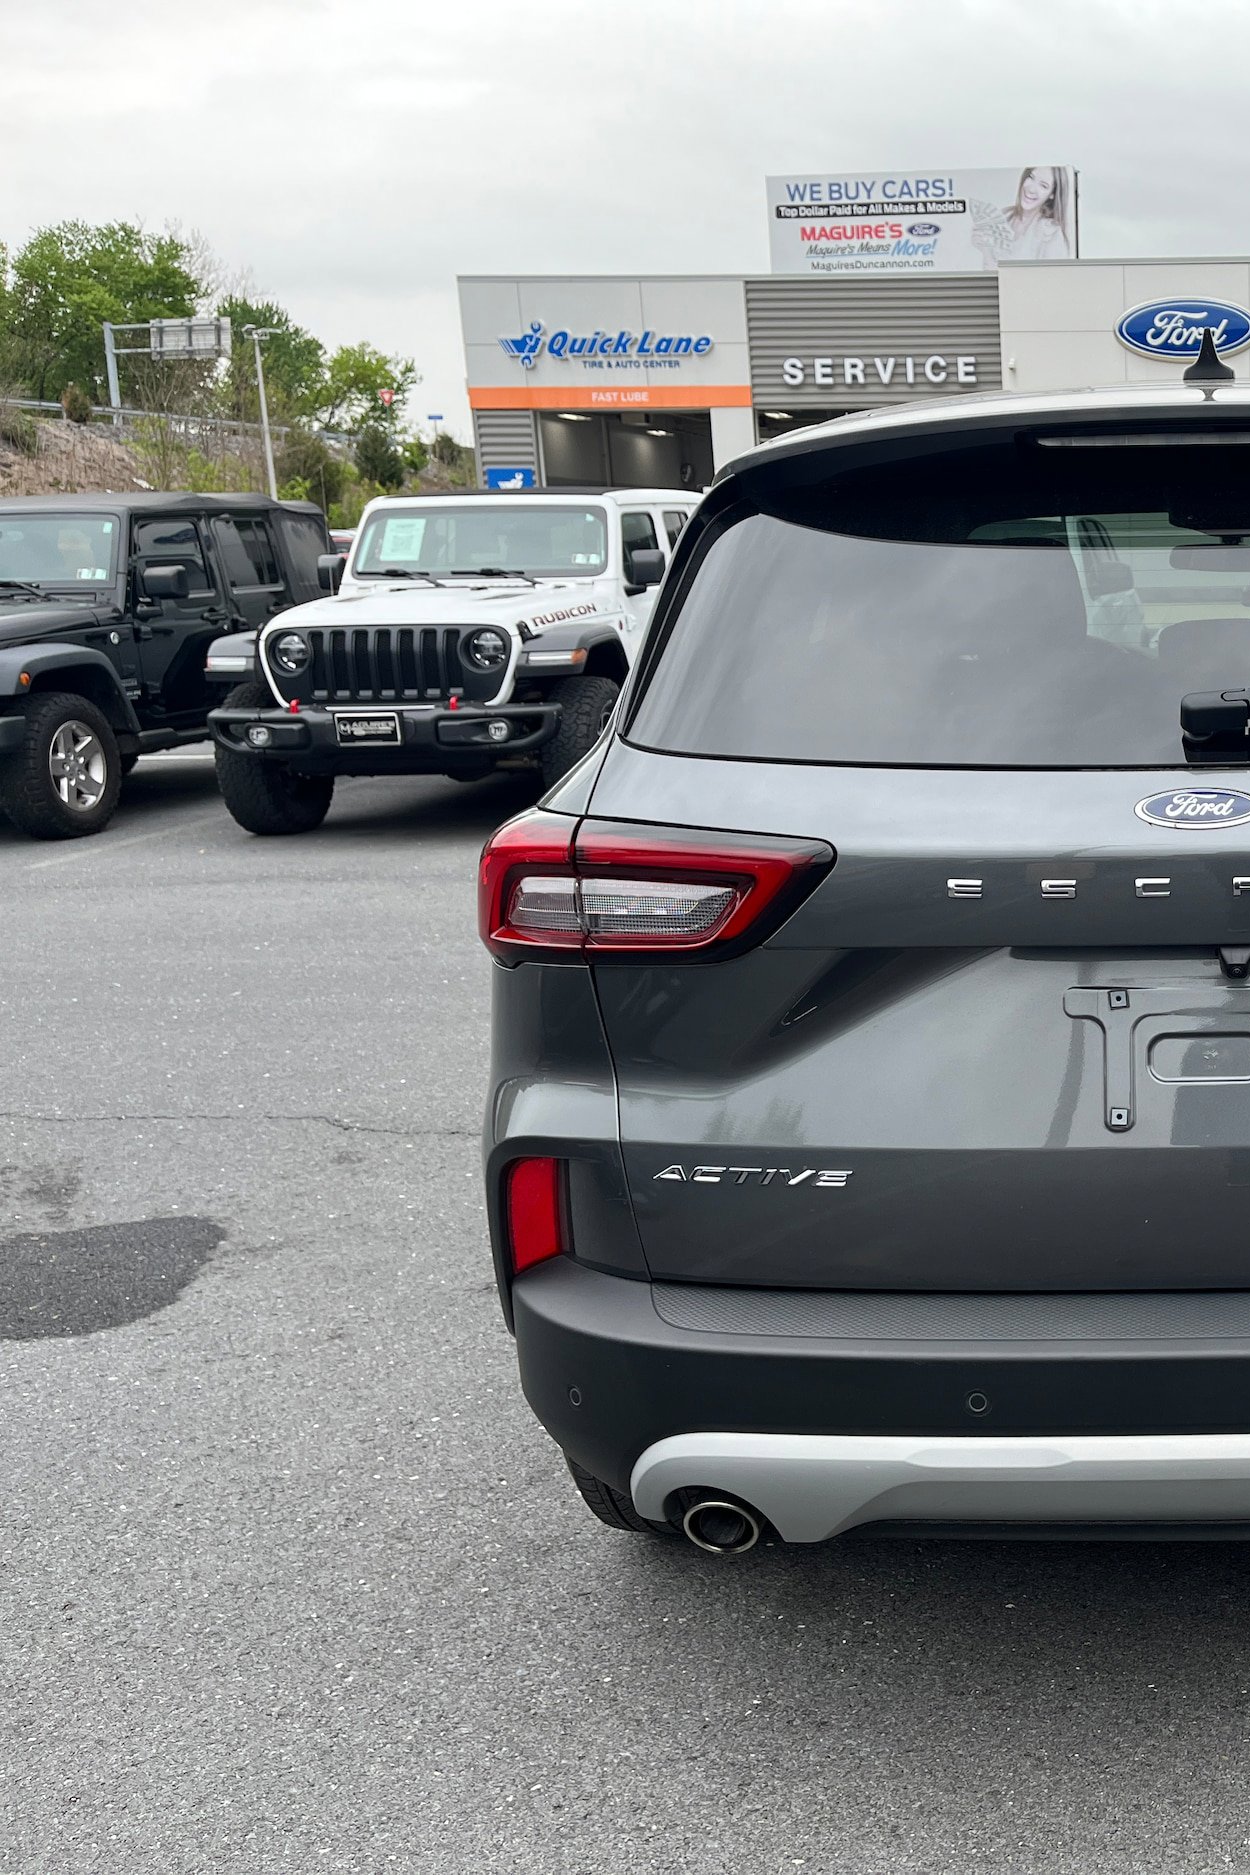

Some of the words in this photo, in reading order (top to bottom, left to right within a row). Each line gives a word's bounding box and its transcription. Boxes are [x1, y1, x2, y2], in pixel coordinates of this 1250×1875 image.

[786, 183, 822, 202] WE
[828, 180, 876, 201] BUY
[882, 178, 954, 199] CARS!
[778, 206, 798, 218] Top
[799, 205, 828, 217] Dollar
[829, 204, 852, 216] Paid
[853, 204, 867, 215] for
[868, 203, 883, 214] All
[884, 202, 916, 214] Makes
[917, 202, 926, 213] &
[927, 200, 965, 213] Models
[800, 221, 903, 241] MAGUIRE'S
[806, 243, 855, 258] Maguire's
[857, 242, 891, 253] Means
[891, 238, 937, 256] More!
[811, 259, 934, 271] MaguiresDuncannon.com
[1145, 310, 1229, 346] Ford
[547, 329, 634, 358] Quick
[637, 330, 712, 355] Lane
[583, 360, 604, 369] TIRE
[606, 360, 613, 368] &
[615, 360, 641, 368] AUTO
[643, 359, 680, 368] CENTER
[782, 355, 977, 386] SERVICE
[591, 392, 618, 402] FAST
[620, 391, 649, 402] LUBE
[531, 603, 597, 627] RUBICON
[1165, 793, 1235, 817] Ford
[652, 1164, 854, 1187] ACTIVE
